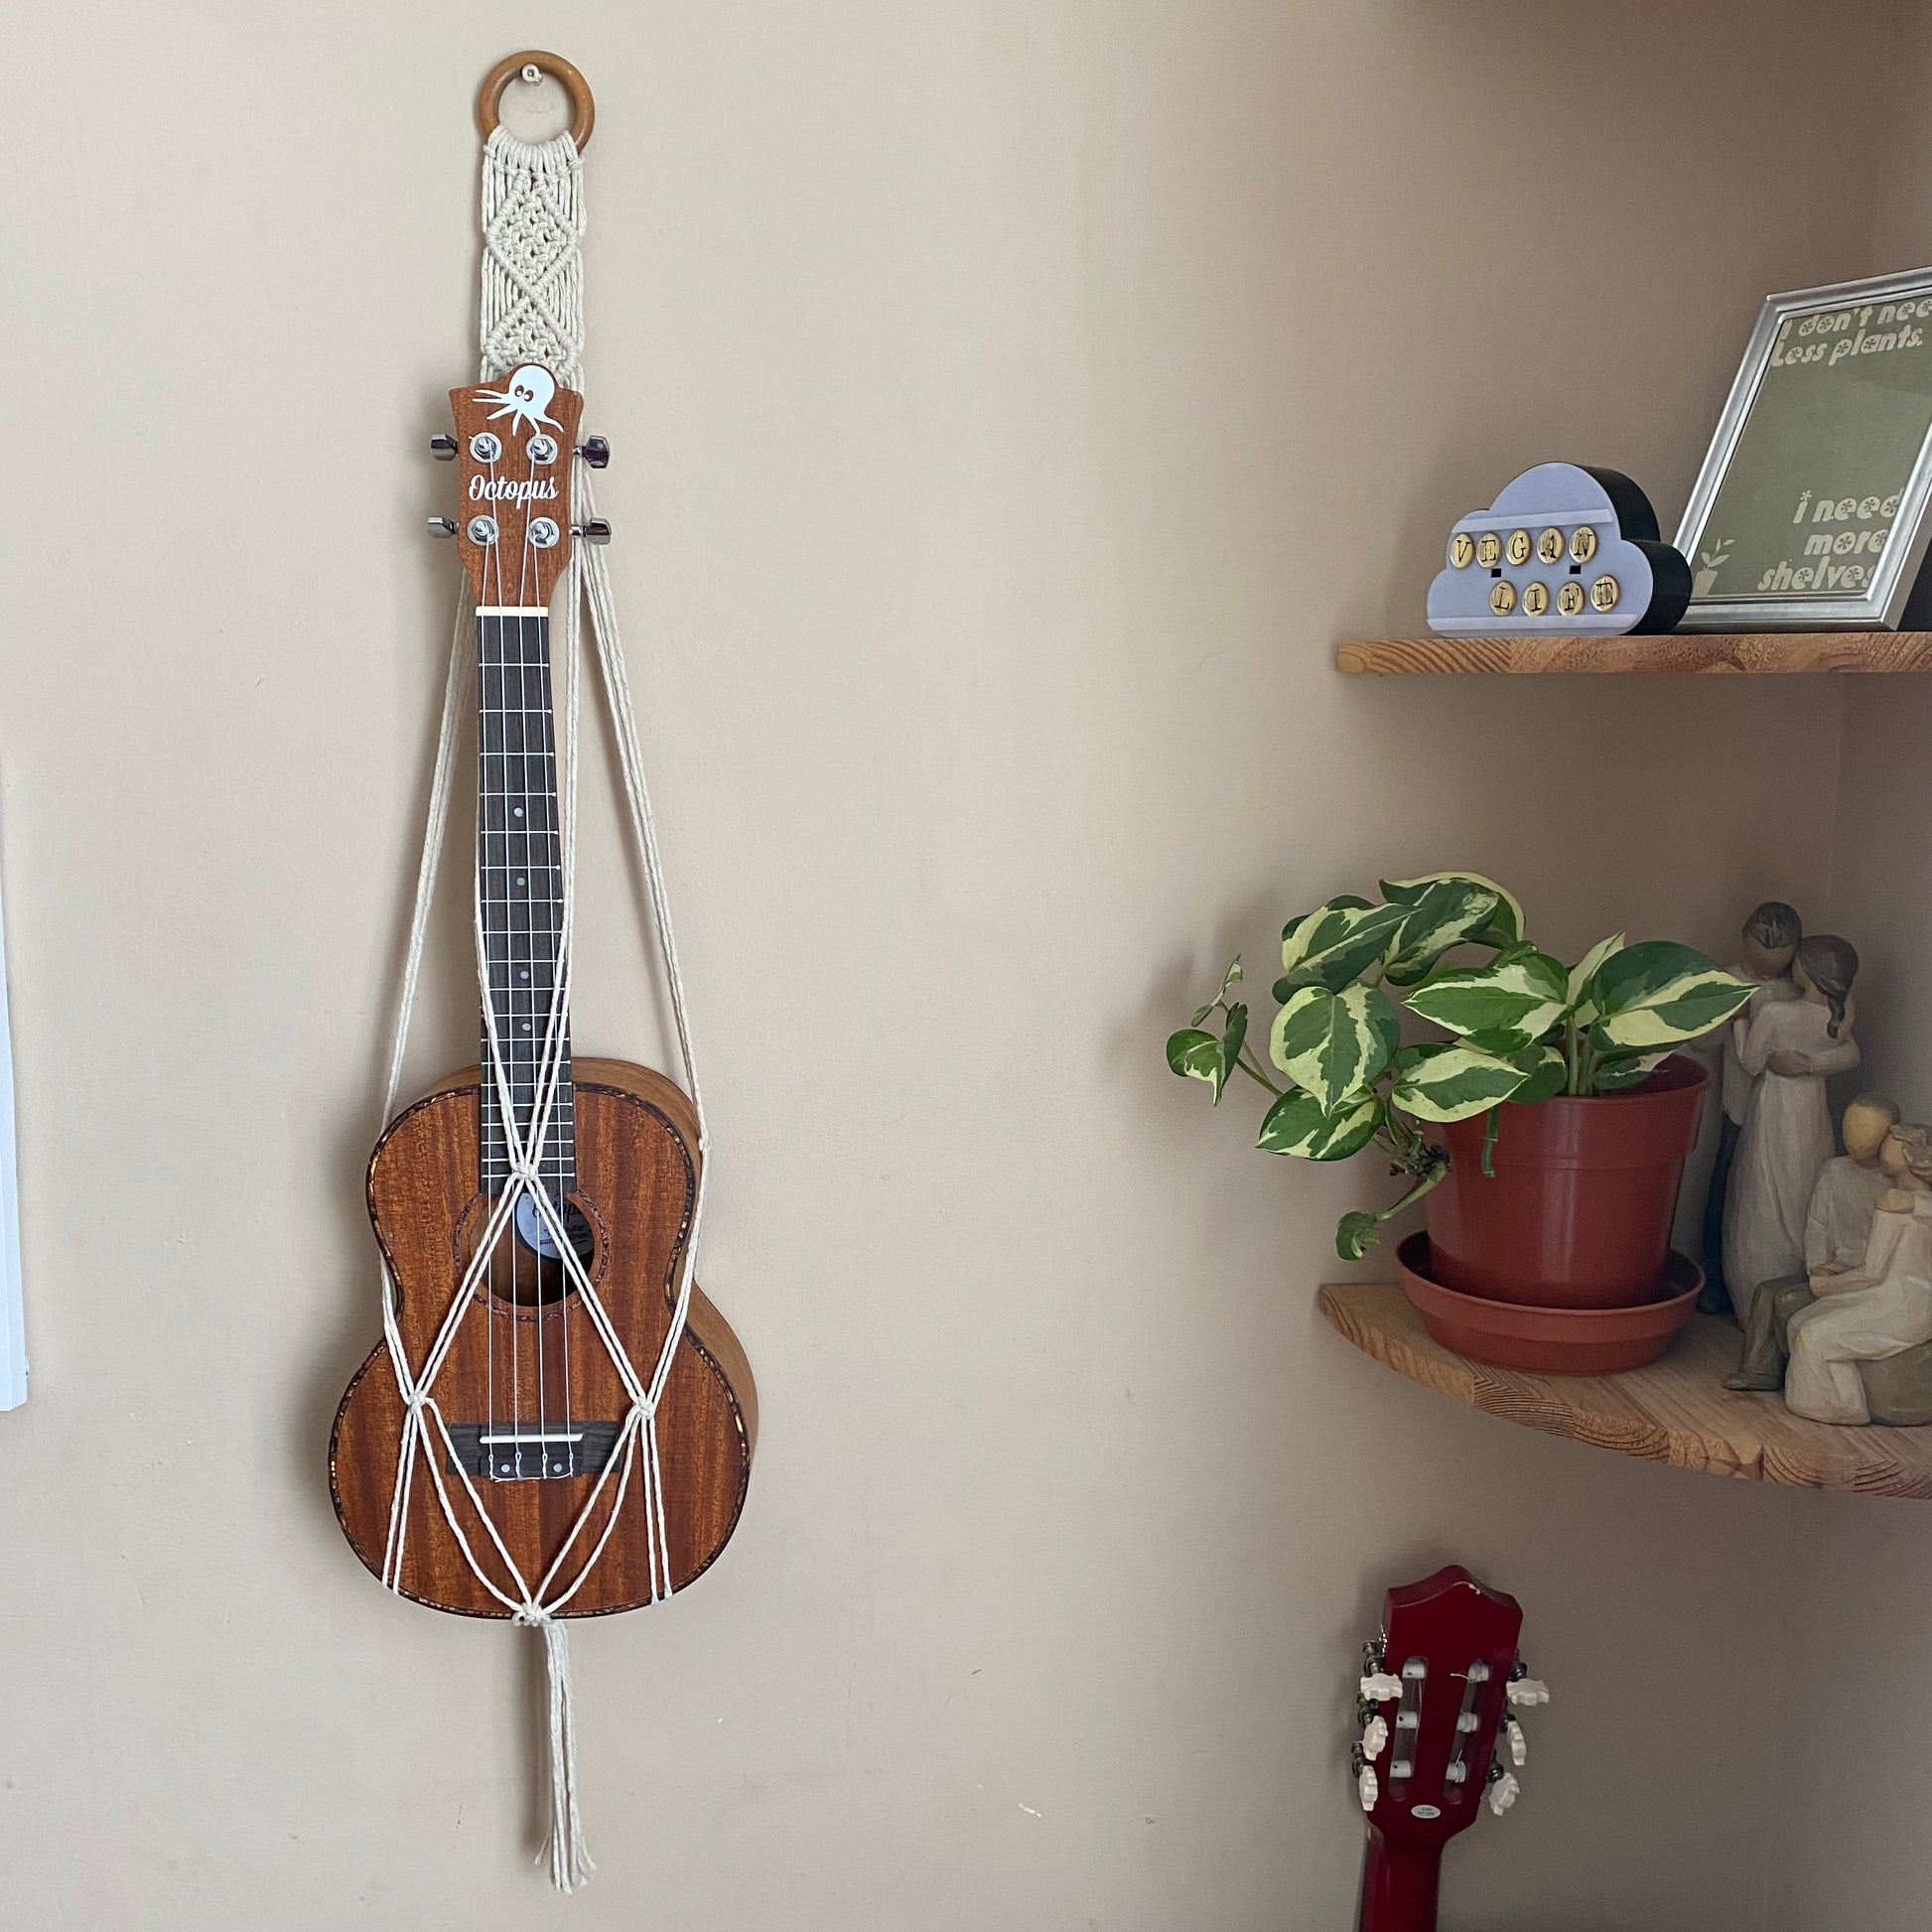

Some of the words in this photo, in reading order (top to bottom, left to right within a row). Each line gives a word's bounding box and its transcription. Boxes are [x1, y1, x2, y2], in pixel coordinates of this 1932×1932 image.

[1798, 305, 1873, 337] don't
[1876, 298, 1932, 325] nee
[1829, 325, 1923, 365] plants.
[469, 475, 559, 509] Octopus
[1456, 532, 1593, 563] VEGAN
[1804, 529, 1888, 555] more
